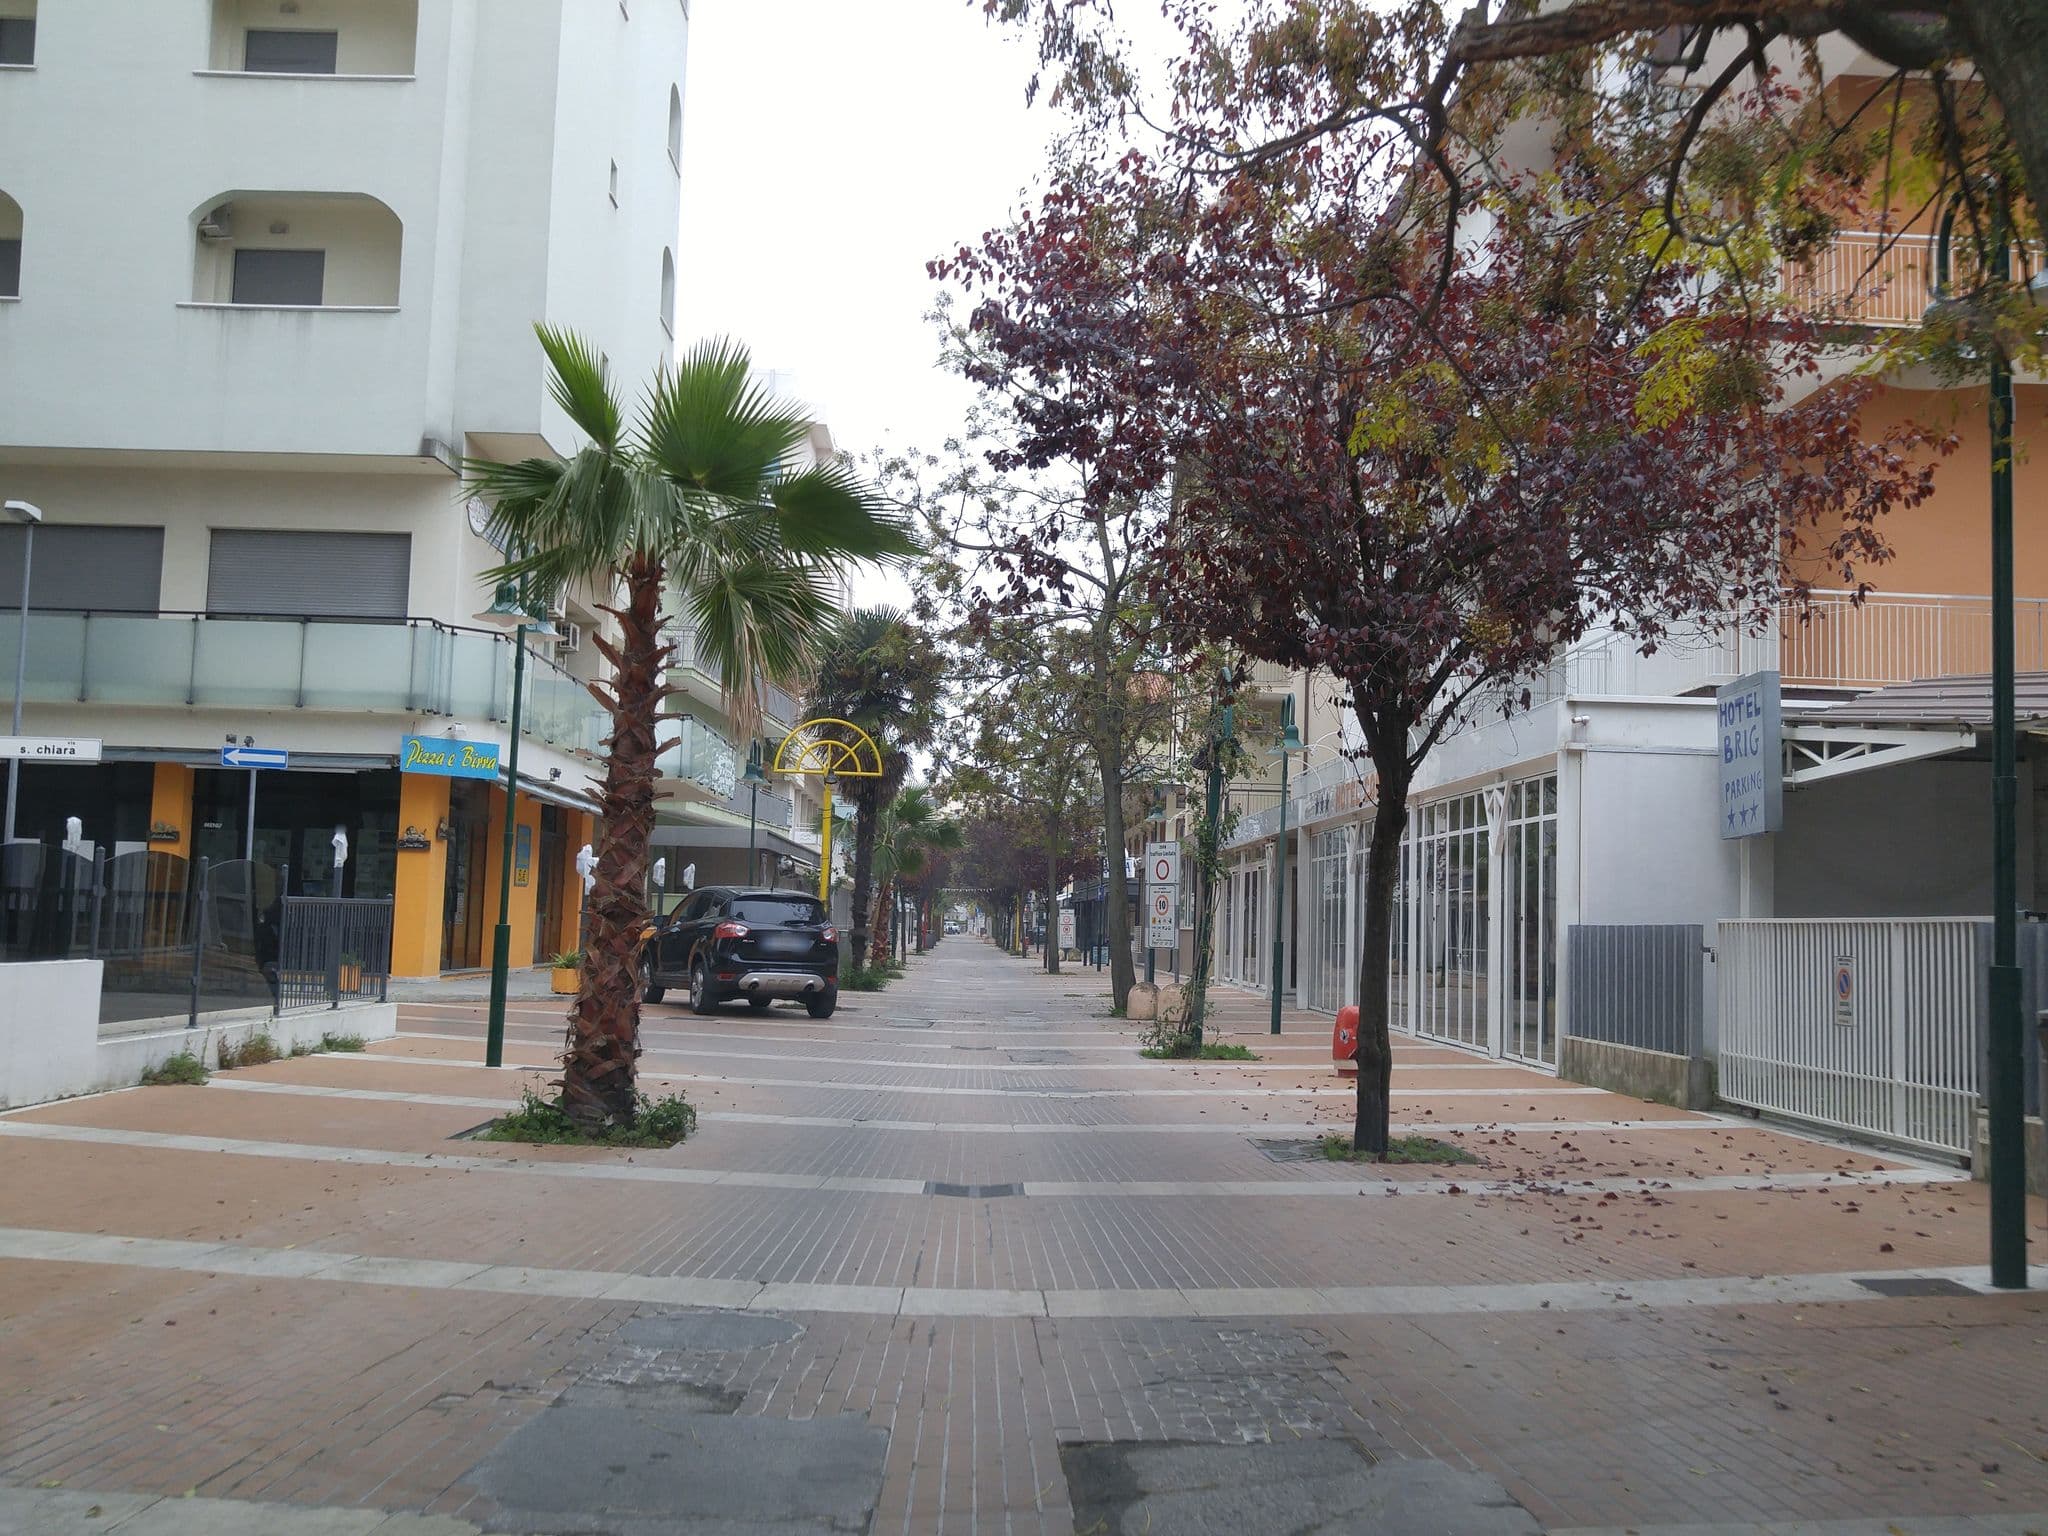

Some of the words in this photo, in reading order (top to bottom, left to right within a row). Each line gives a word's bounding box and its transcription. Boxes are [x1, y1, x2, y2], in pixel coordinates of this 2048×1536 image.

[1719, 691, 1761, 728] HOTEL
[20, 746, 30, 754] s.
[36, 745, 76, 755] chiara
[405, 739, 445, 769] Pizza
[447, 753, 456, 767] e
[460, 744, 497, 769] Birra
[1723, 724, 1760, 764] BRIG
[1725, 770, 1762, 803] PARKING
[1158, 900, 1166, 910] 10
